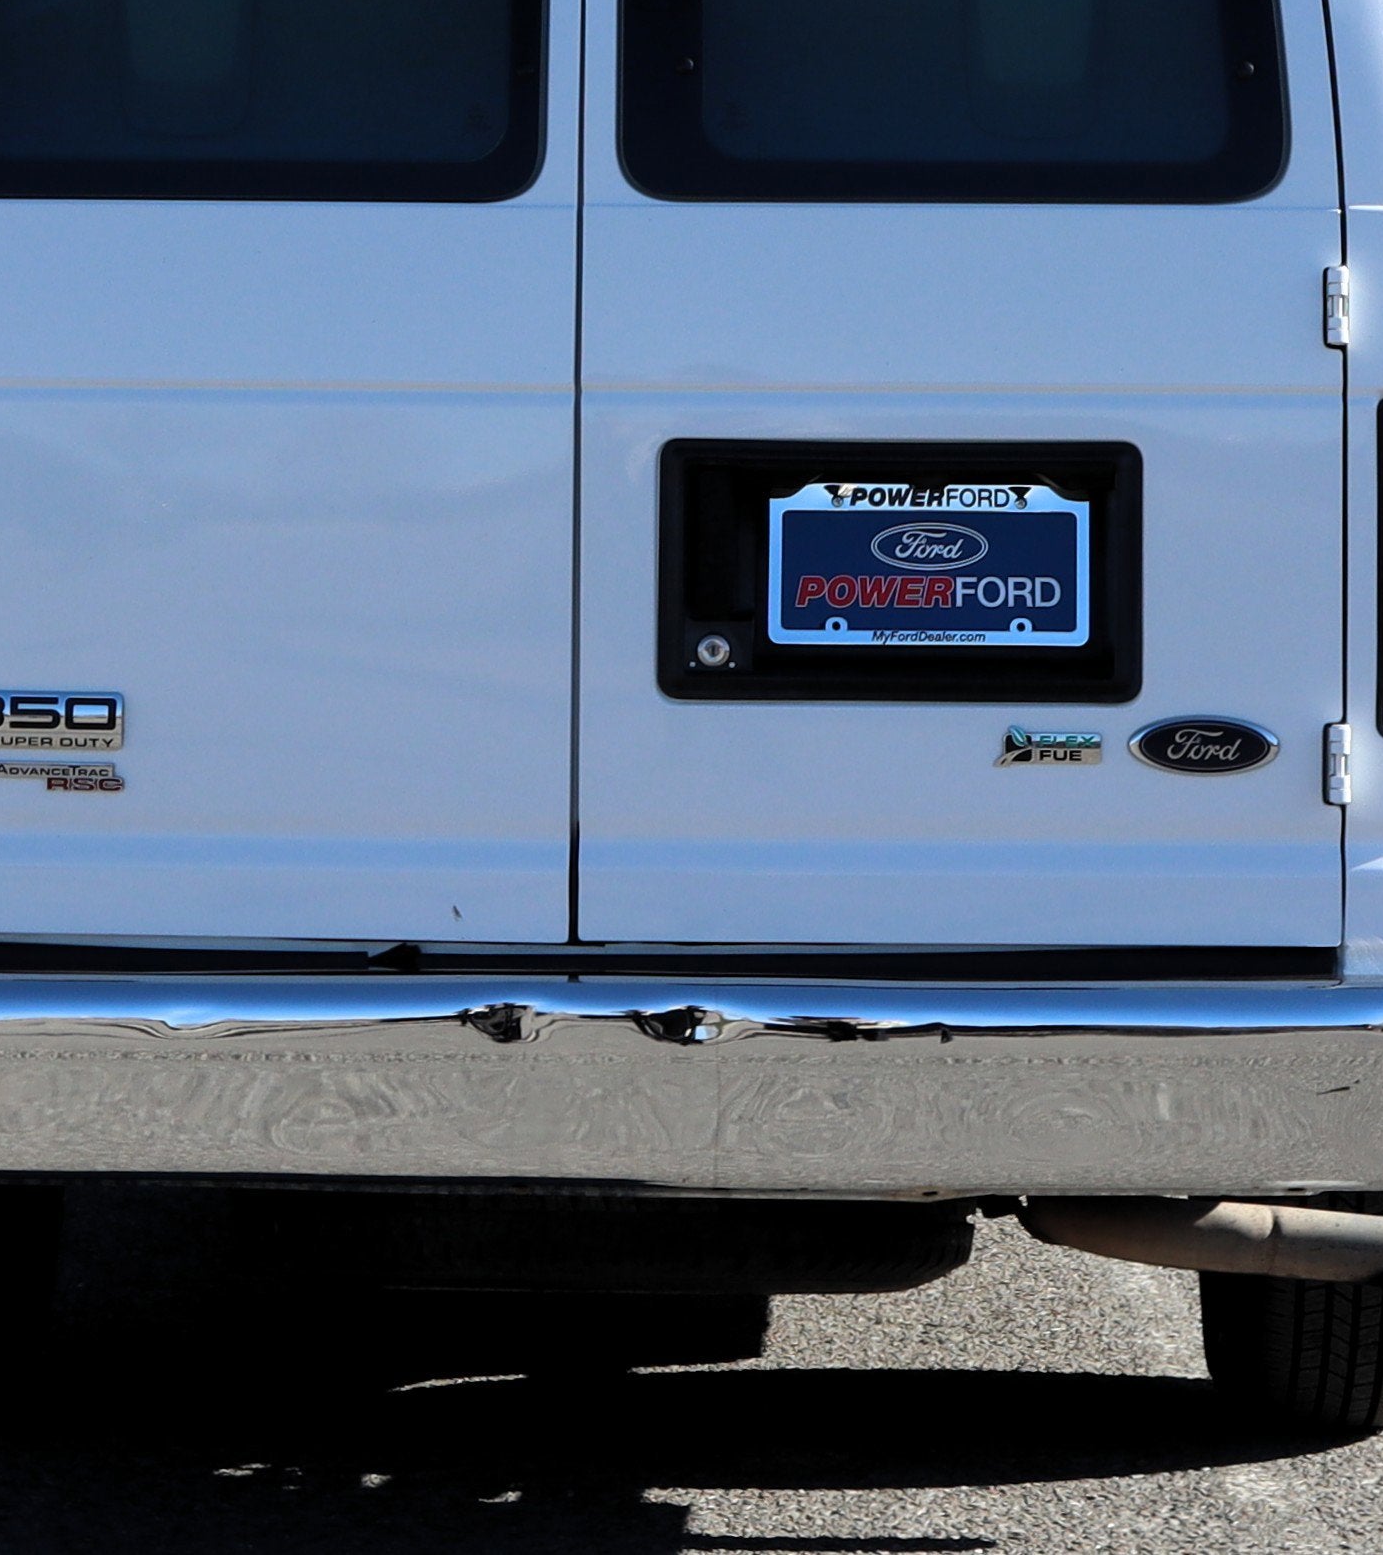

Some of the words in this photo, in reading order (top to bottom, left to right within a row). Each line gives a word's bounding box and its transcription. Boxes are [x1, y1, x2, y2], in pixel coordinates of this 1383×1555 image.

[894, 530, 964, 560] Ford
[871, 630, 986, 645] MyFordDealer.com
[60, 737, 114, 748] DUTY
[1168, 728, 1243, 762] Ford
[46, 777, 122, 792] RSC
